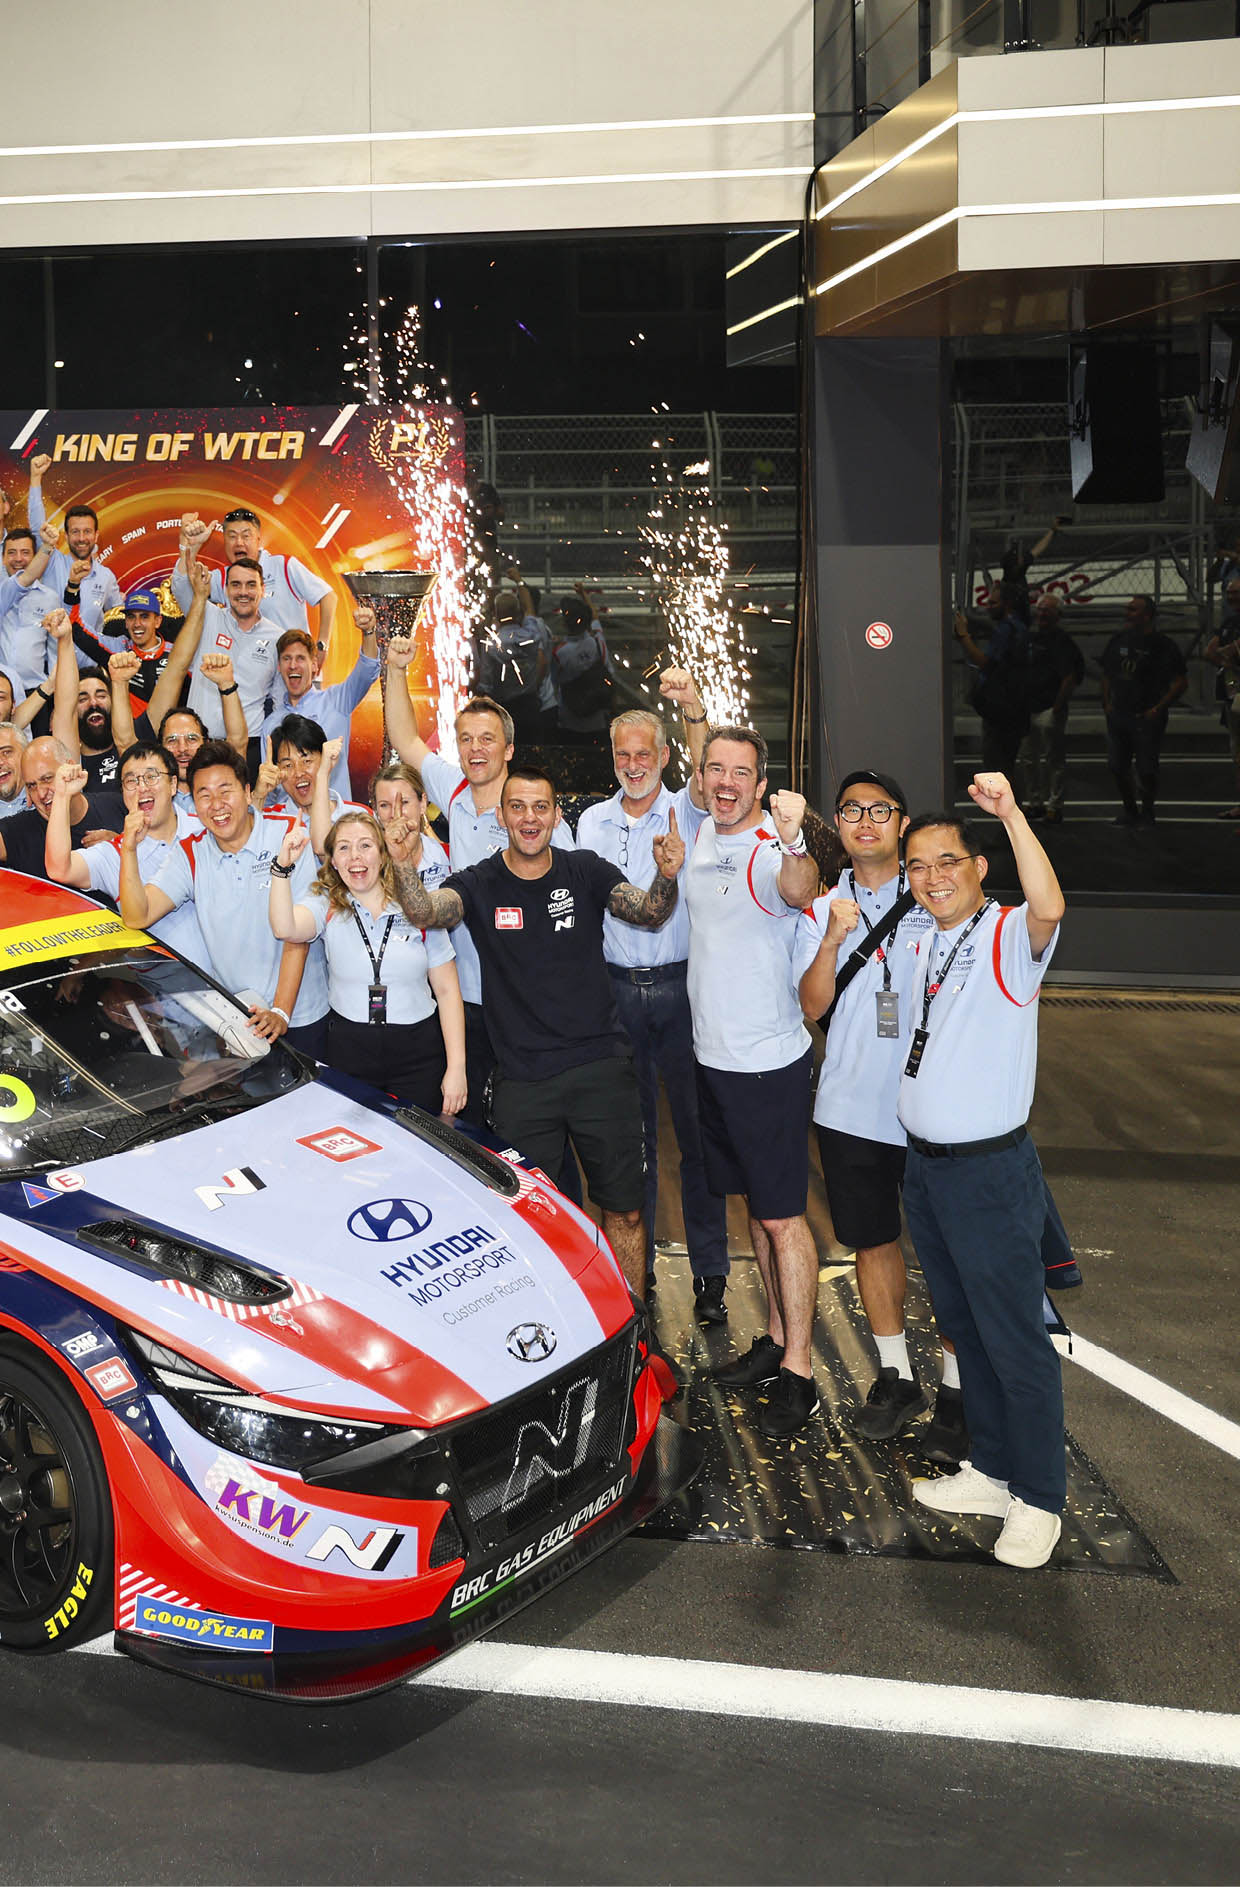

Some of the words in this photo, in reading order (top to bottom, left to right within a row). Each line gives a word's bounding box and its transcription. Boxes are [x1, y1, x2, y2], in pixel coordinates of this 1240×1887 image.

[52, 434, 139, 463] KING
[145, 433, 194, 461] OF
[204, 431, 305, 461] WTCR
[121, 526, 146, 544] SPAIN
[5, 921, 126, 958] #FOLLOWTHELEADER
[323, 1135, 355, 1151] BRC
[55, 1174, 81, 1188] E
[380, 1225, 497, 1287] HYUNDAI
[407, 1246, 518, 1307] MOTORSPORT
[442, 1292, 498, 1326] Customer
[498, 1272, 536, 1304] Racing
[66, 1334, 99, 1356] OMP
[100, 1365, 123, 1386] BRC
[214, 1504, 295, 1549] kwsuspensions.de
[217, 1478, 312, 1538] KW
[451, 1569, 492, 1609] BRC
[495, 1543, 535, 1582] GAS
[537, 1474, 628, 1556] EQUIPMENT
[43, 1562, 94, 1640] EAGLE
